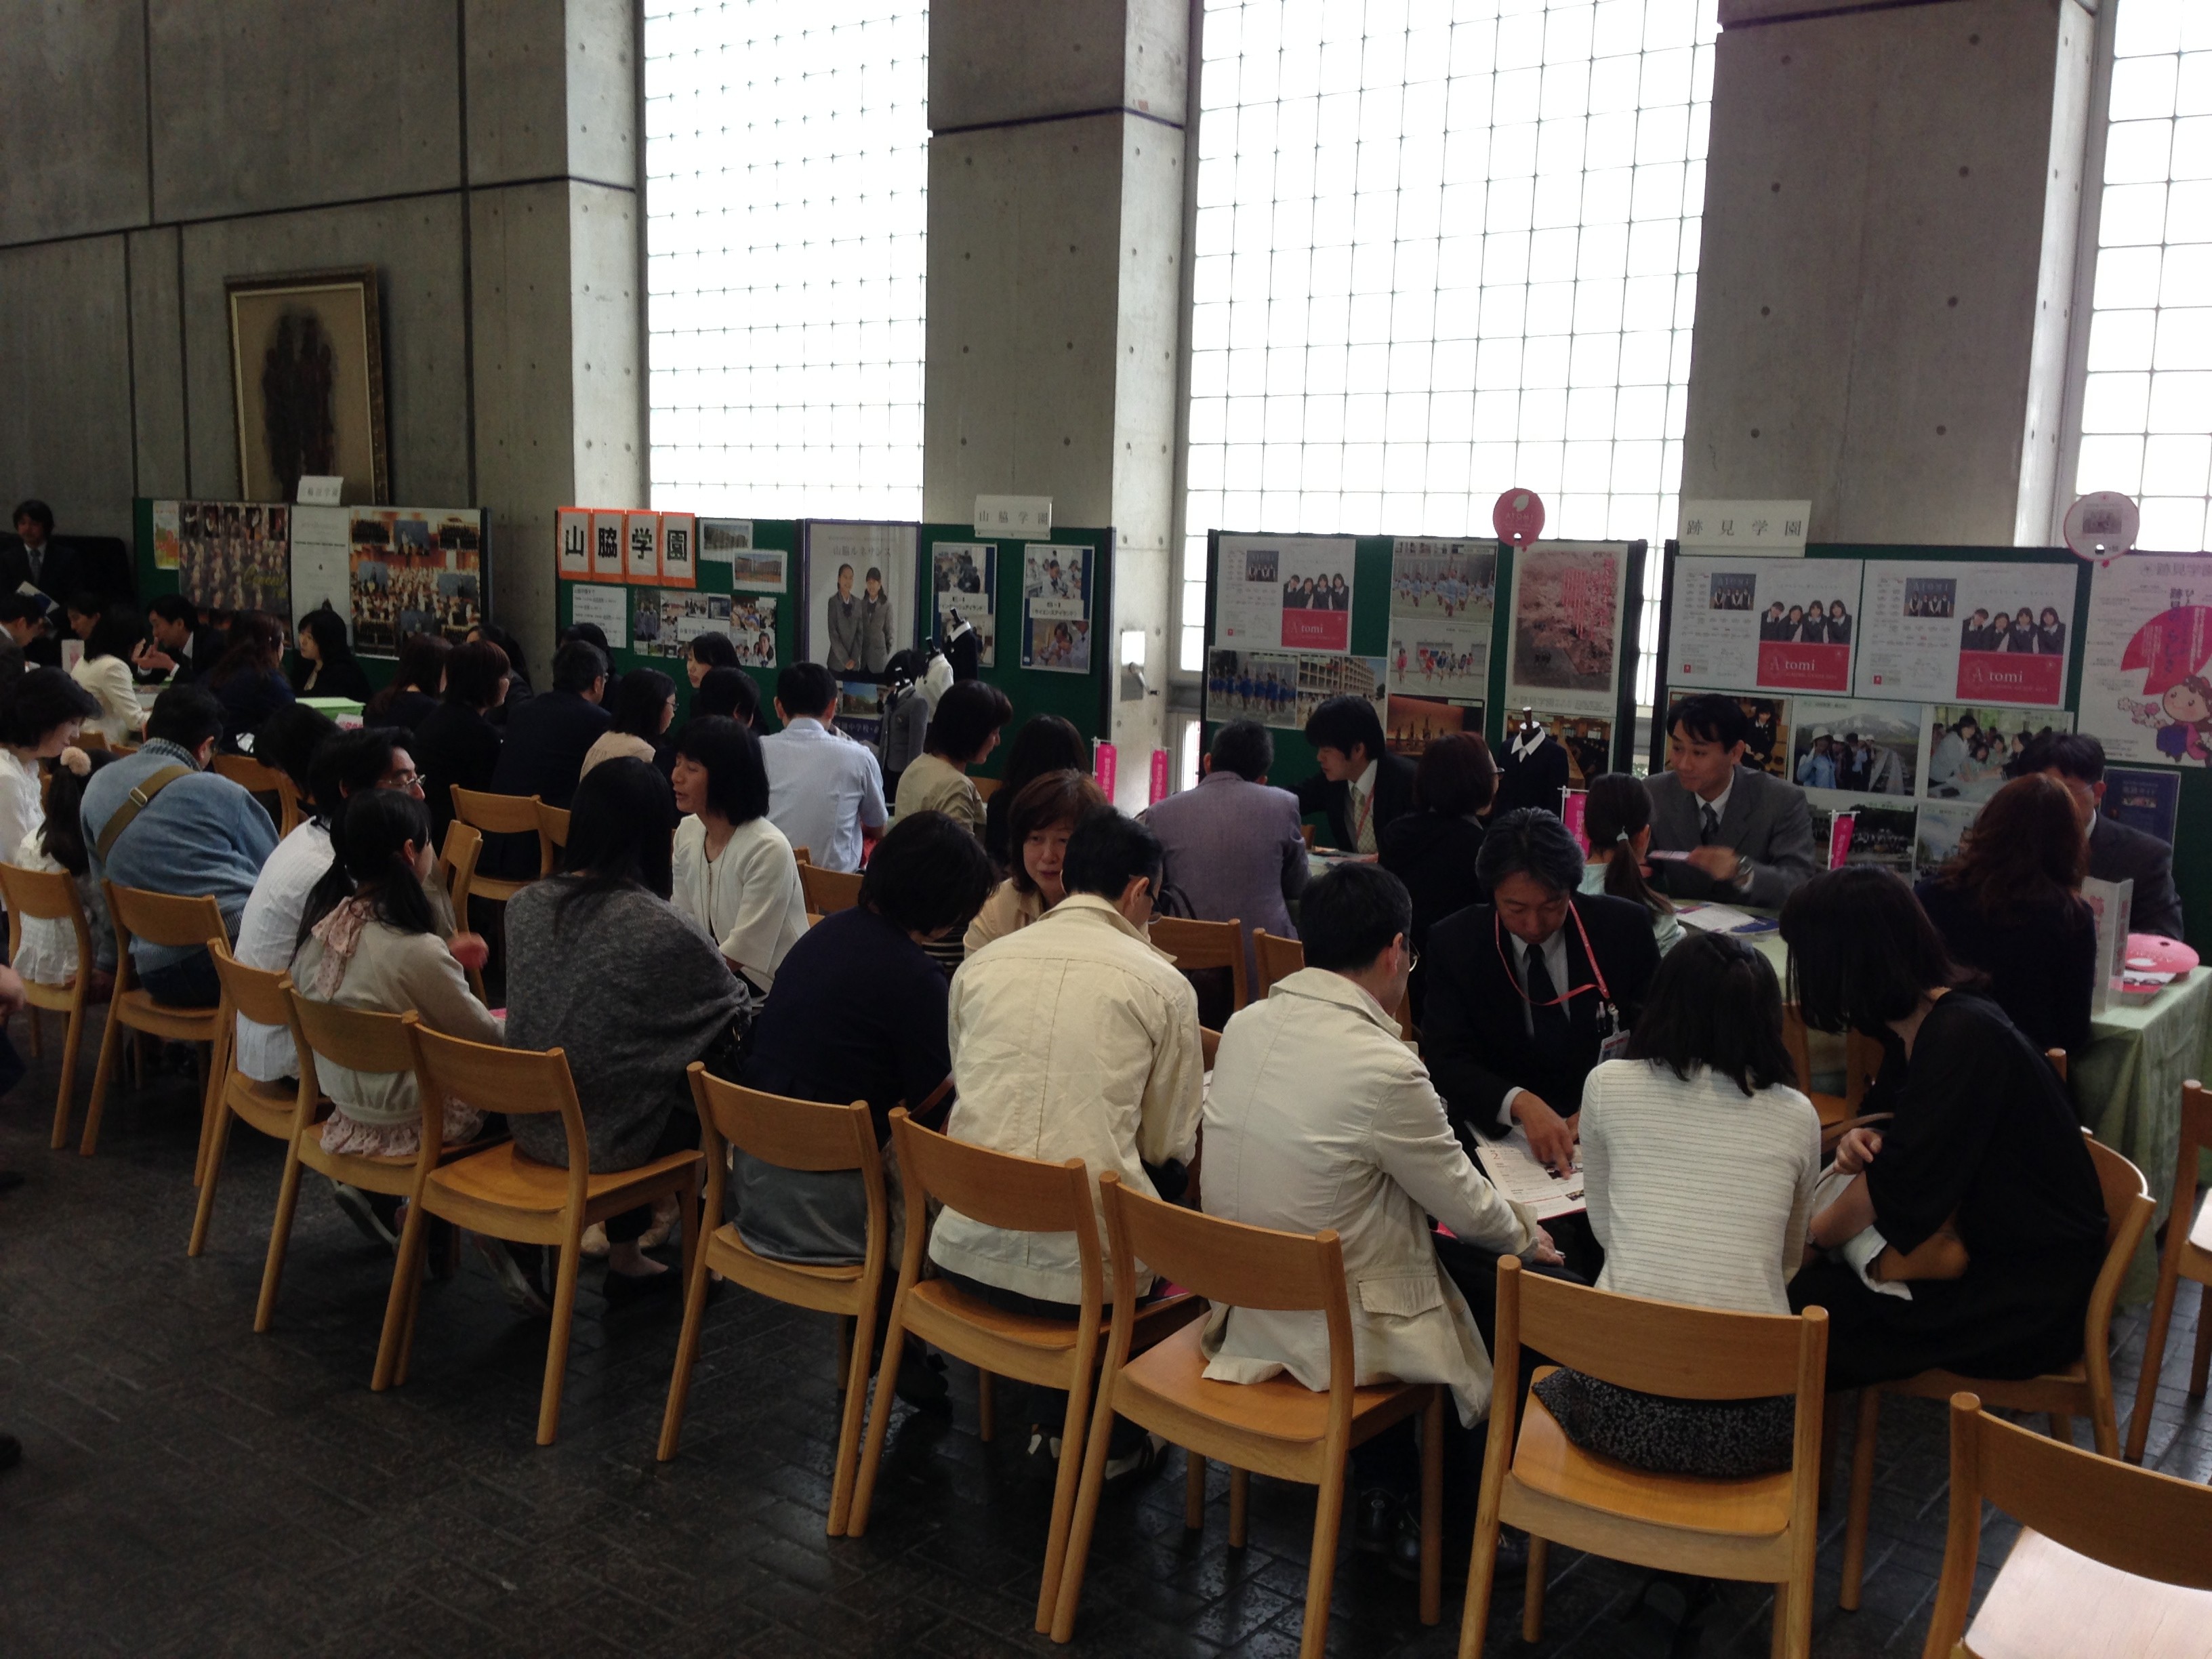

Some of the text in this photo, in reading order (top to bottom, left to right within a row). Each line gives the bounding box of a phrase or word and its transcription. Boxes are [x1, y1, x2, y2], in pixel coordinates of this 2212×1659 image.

[979, 510, 1048, 525] 山脇学園
[1687, 520, 1801, 536] 跡見学園
[565, 525, 688, 562] 山脇学園
